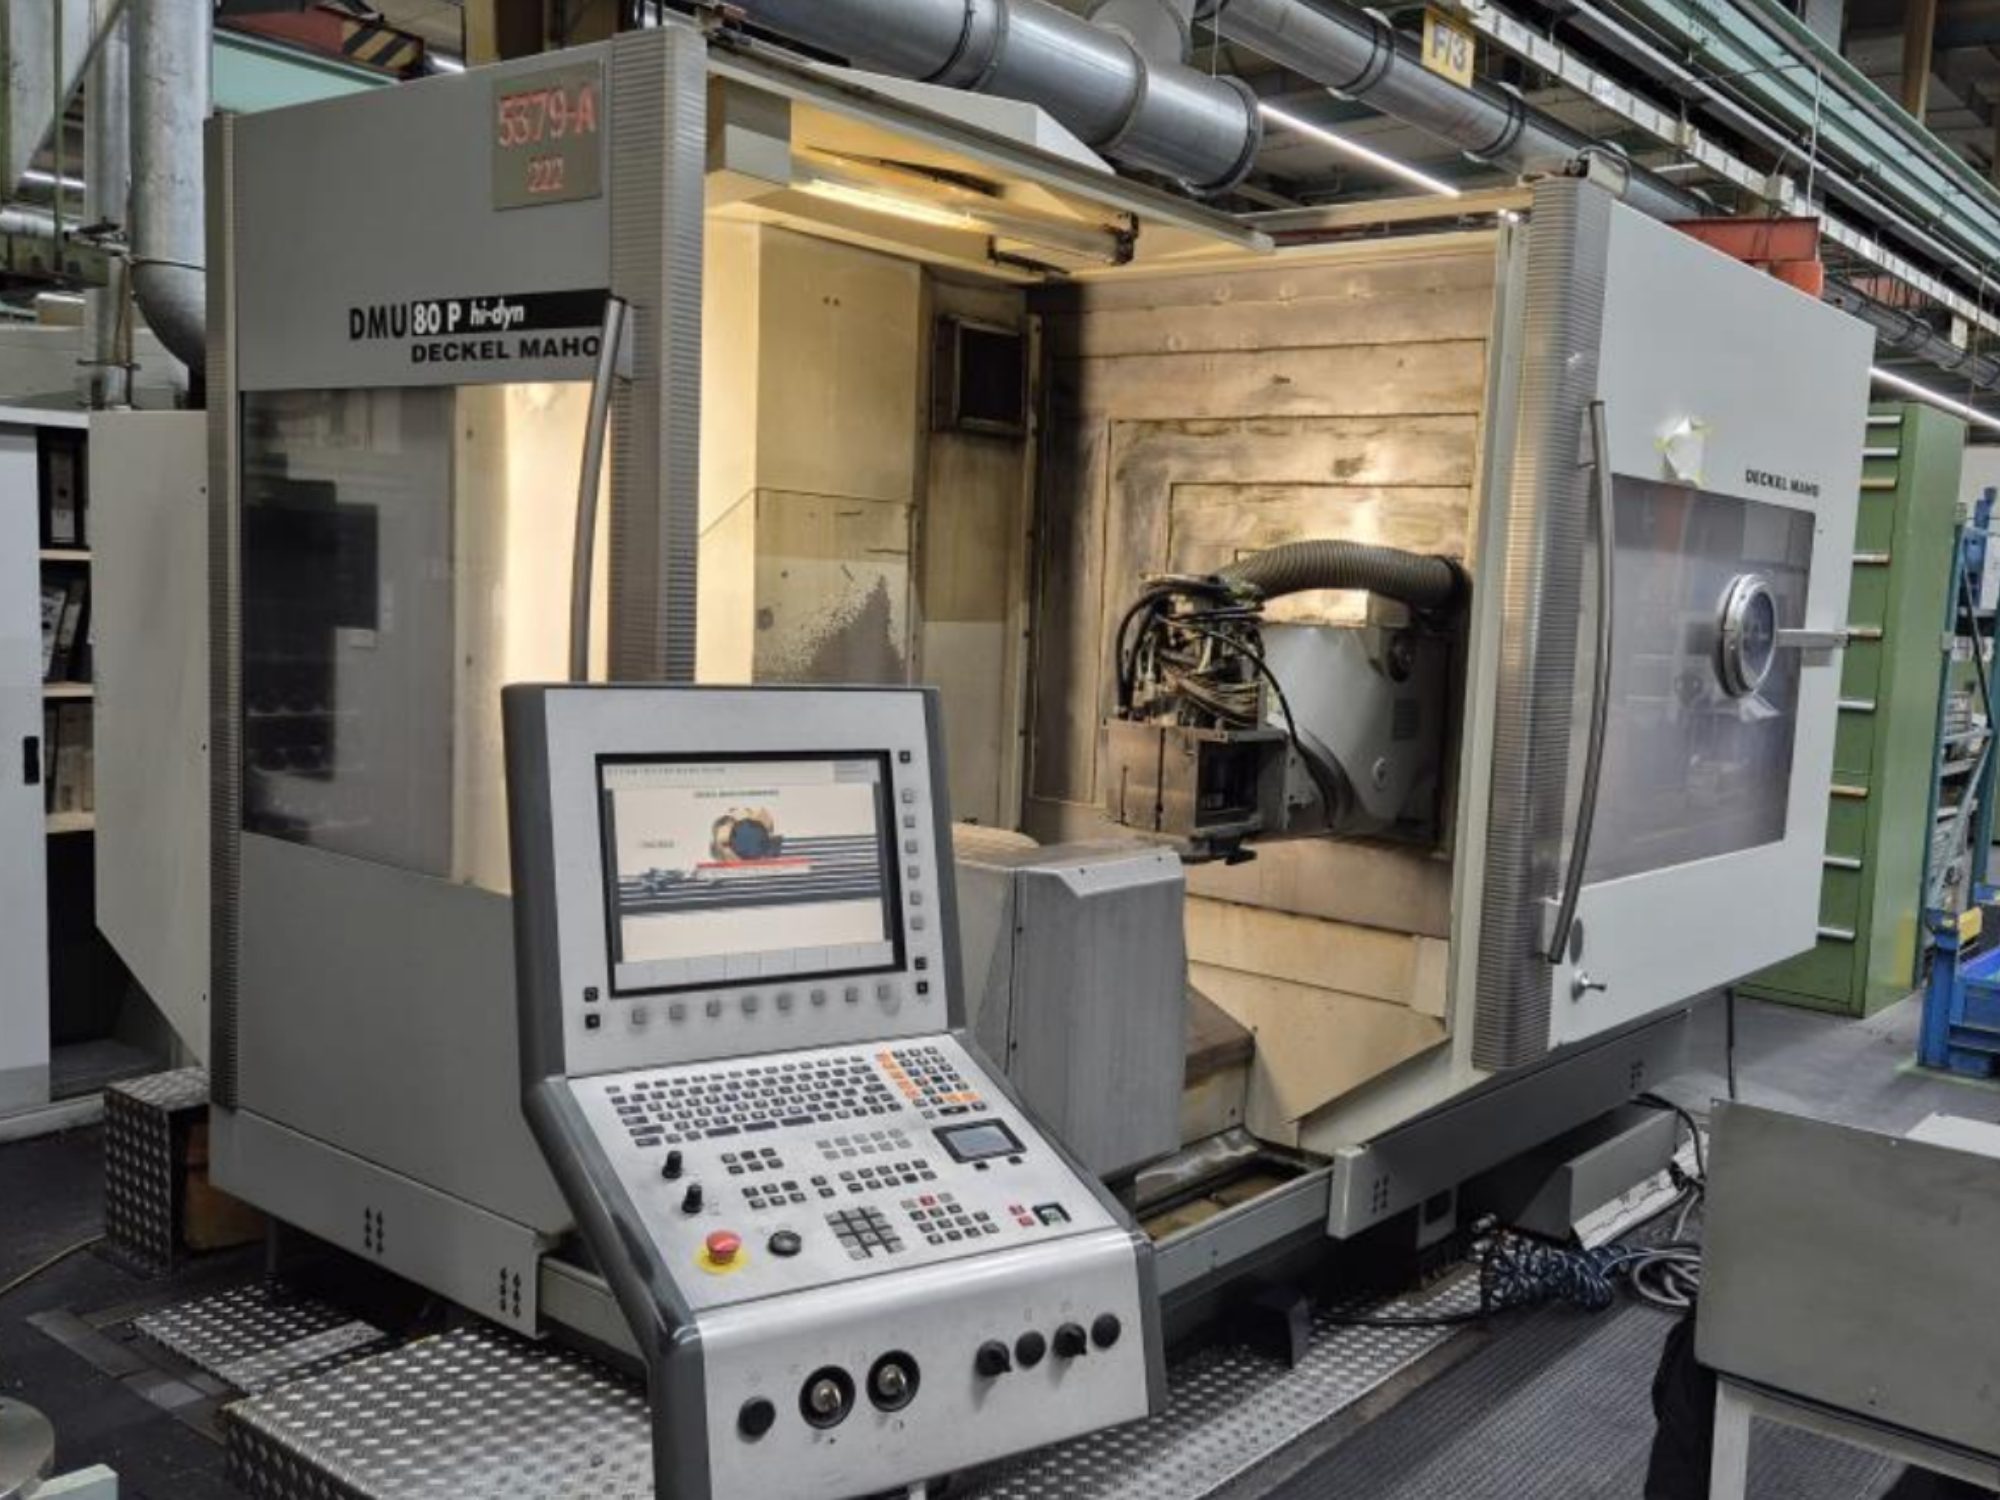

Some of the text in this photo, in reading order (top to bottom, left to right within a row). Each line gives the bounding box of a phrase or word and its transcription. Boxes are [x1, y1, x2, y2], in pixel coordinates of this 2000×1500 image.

[526, 158, 564, 193] 222
[349, 298, 525, 340] DMU 80 P hi-dyn
[411, 335, 600, 364] DECKEL MAHO
[1745, 469, 1819, 498] DECKEL MAHO
